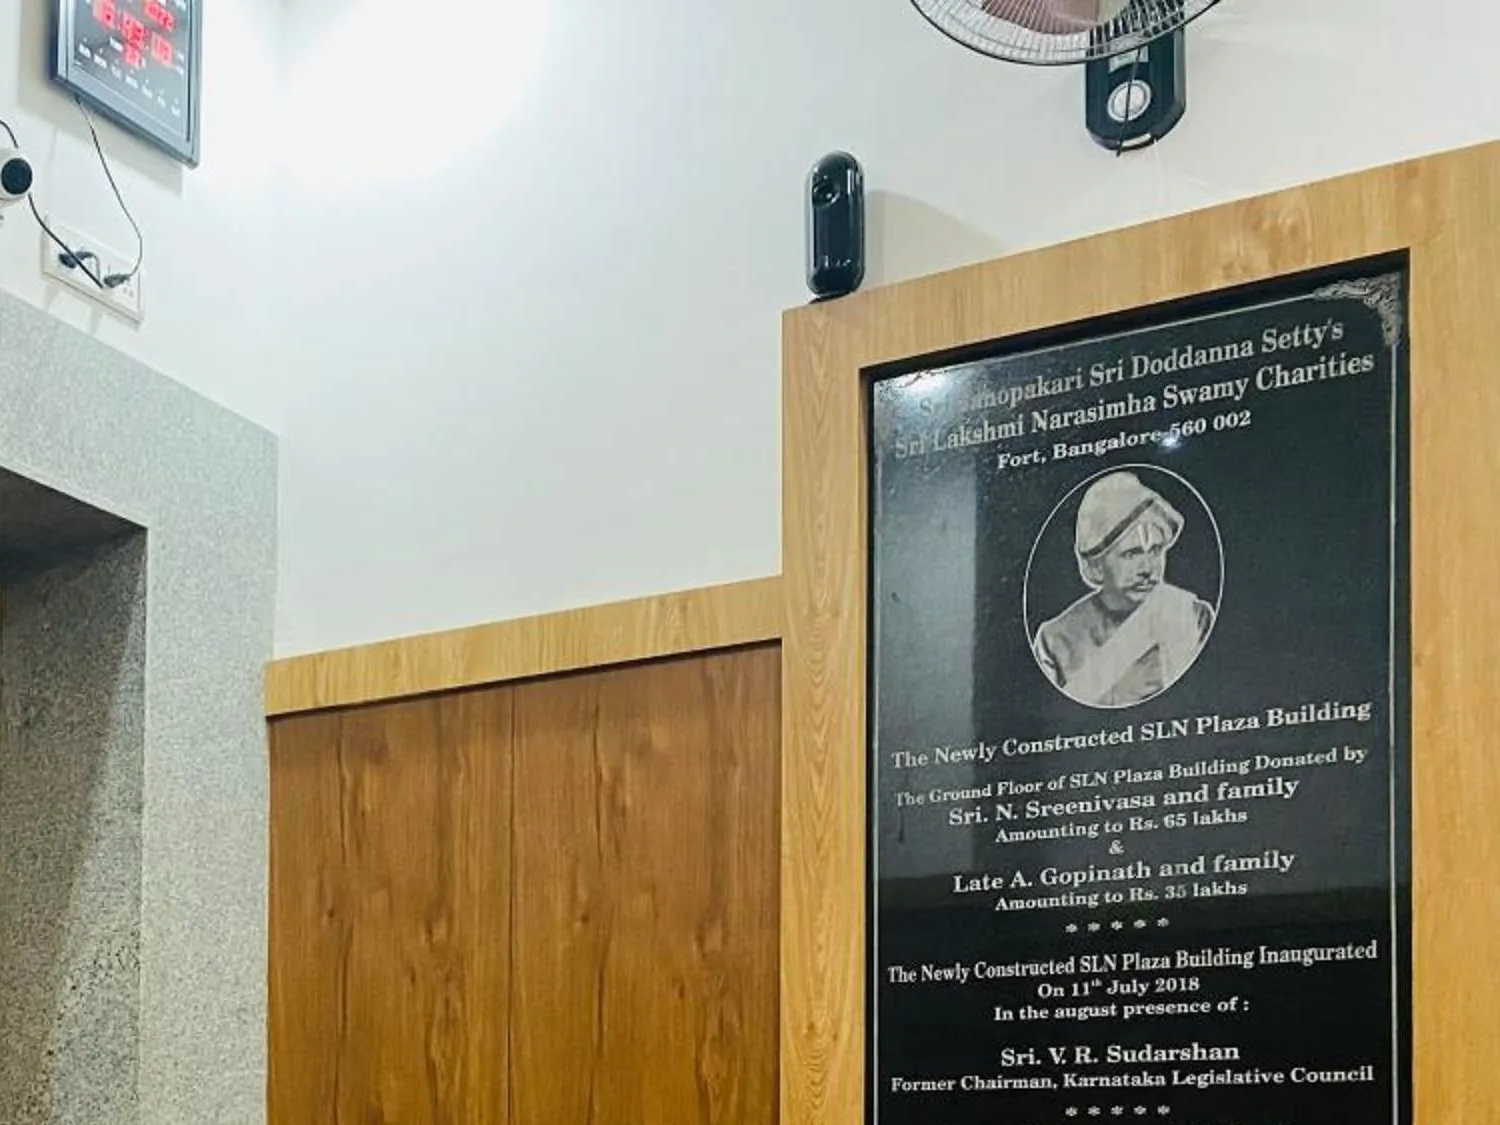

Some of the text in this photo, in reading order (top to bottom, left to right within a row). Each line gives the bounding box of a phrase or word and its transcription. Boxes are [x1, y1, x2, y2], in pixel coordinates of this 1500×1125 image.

[1089, 358, 1124, 386] Sri
[1130, 340, 1254, 378] Doddanna
[1261, 318, 1343, 353] Setty's
[894, 352, 1374, 460] Sri Lakshmi Narasimha Swamy Charities
[998, 449, 1047, 470] Fort,
[1213, 409, 1250, 430] 002
[890, 701, 1372, 768] The Newly Constructed SLN Plaza Building
[894, 745, 1368, 807] The Ground Floor of SLN Plaza Building Donated by
[949, 776, 1299, 825] Sri. N. Sreenivasa and family
[995, 808, 1248, 843] Amounting to Rs. 65 lakhs
[1108, 839, 1124, 854] &
[950, 850, 1294, 892] Late A. Gopinath and family
[995, 880, 1248, 911] Amounting to Rs. 35 lakhs
[887, 939, 1377, 984] The Newly Constructed SLN Plaza Building Inaugurated
[1037, 983, 1064, 998] On
[1106, 979, 1150, 996] July
[1155, 976, 1200, 992] 2018
[994, 1006, 1014, 1021] In
[1019, 1005, 1048, 1020] the
[1054, 1002, 1117, 1020] august
[1123, 1001, 1211, 1019] presence
[1217, 996, 1238, 1012] of
[1001, 1042, 1240, 1066] Sri. V. R. Sudarshan
[891, 1065, 1374, 1092] Former Chairman, Karnataka Legislative Council
